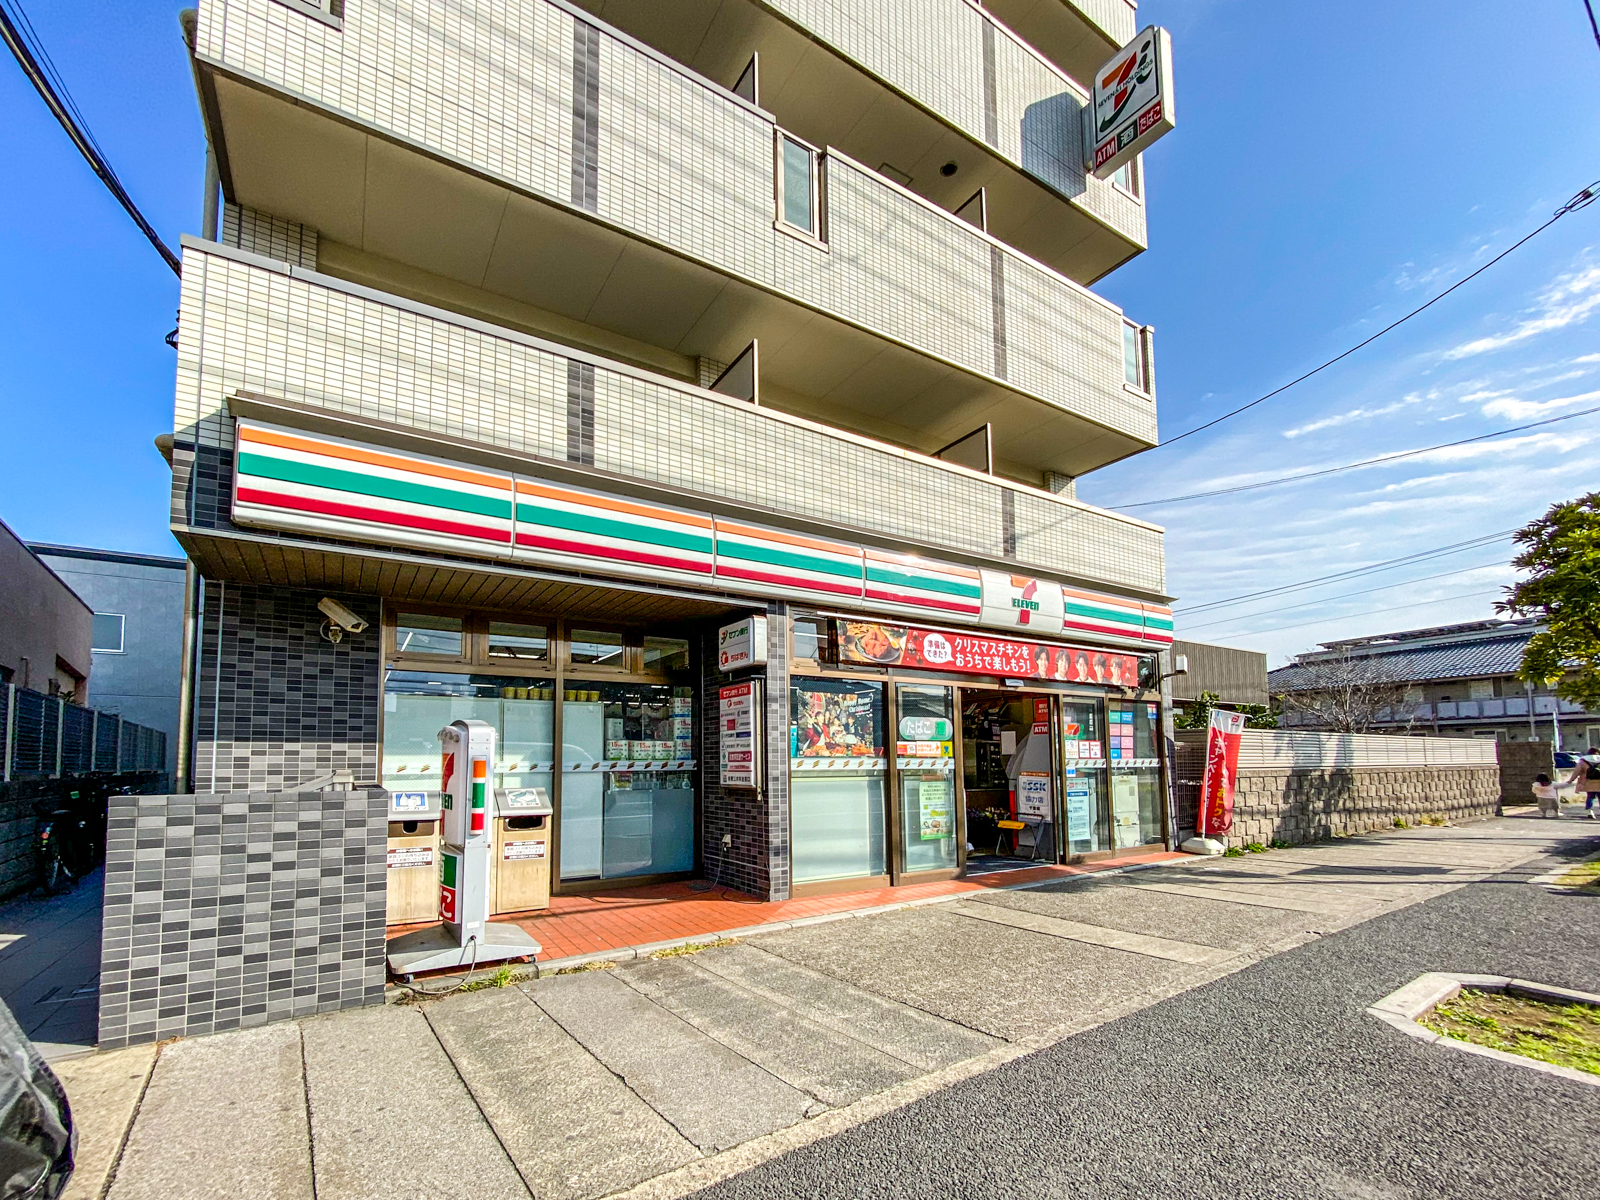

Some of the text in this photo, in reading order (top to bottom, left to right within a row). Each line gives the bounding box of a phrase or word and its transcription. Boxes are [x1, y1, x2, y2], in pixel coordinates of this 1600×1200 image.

[1123, 58, 1154, 87] HOLDINGS
[1096, 105, 1161, 166] ATM 酒 たばこ
[728, 626, 749, 639] セブン銀行
[927, 639, 946, 650] 準備は
[954, 637, 1030, 659] クリスマスチキンを
[955, 653, 1031, 673] おうちで楽しもう!
[906, 719, 932, 735] たばこ
[1034, 725, 1048, 734] ATM
[1027, 781, 1047, 791] SSK
[1025, 795, 1044, 803] 協力店
